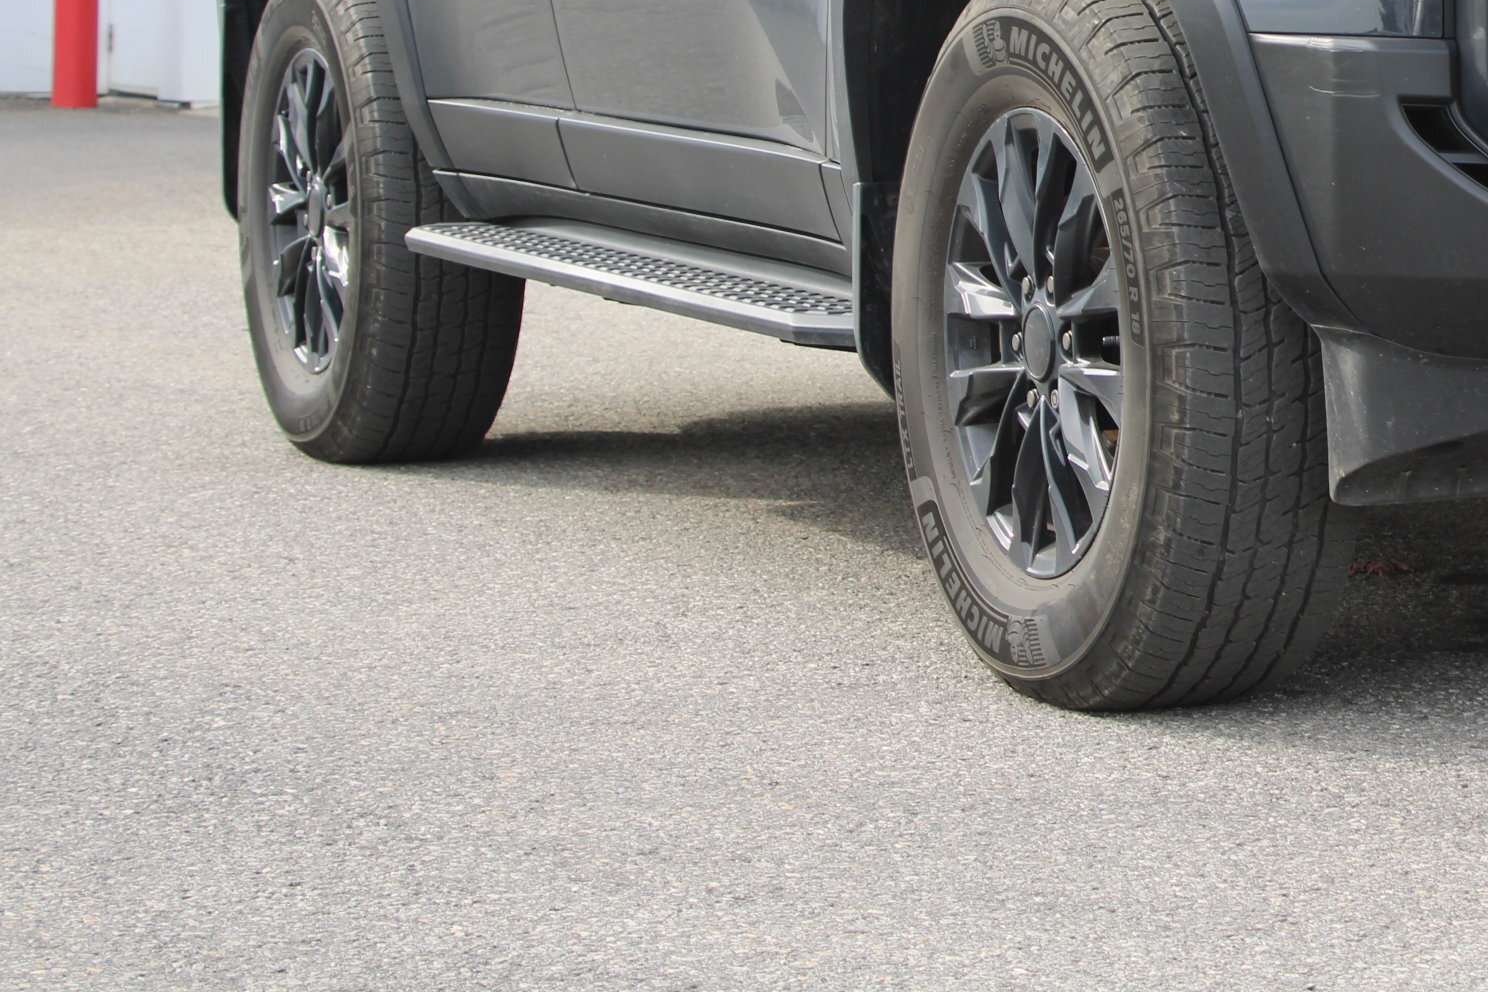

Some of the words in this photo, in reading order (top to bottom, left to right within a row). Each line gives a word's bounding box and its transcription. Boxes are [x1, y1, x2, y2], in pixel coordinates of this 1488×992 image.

[1009, 26, 1106, 161] MICHELIN
[1113, 197, 1137, 278] 265/70
[1128, 286, 1139, 302] R
[901, 428, 913, 468] LTX
[921, 511, 1004, 654] MICHELIN
